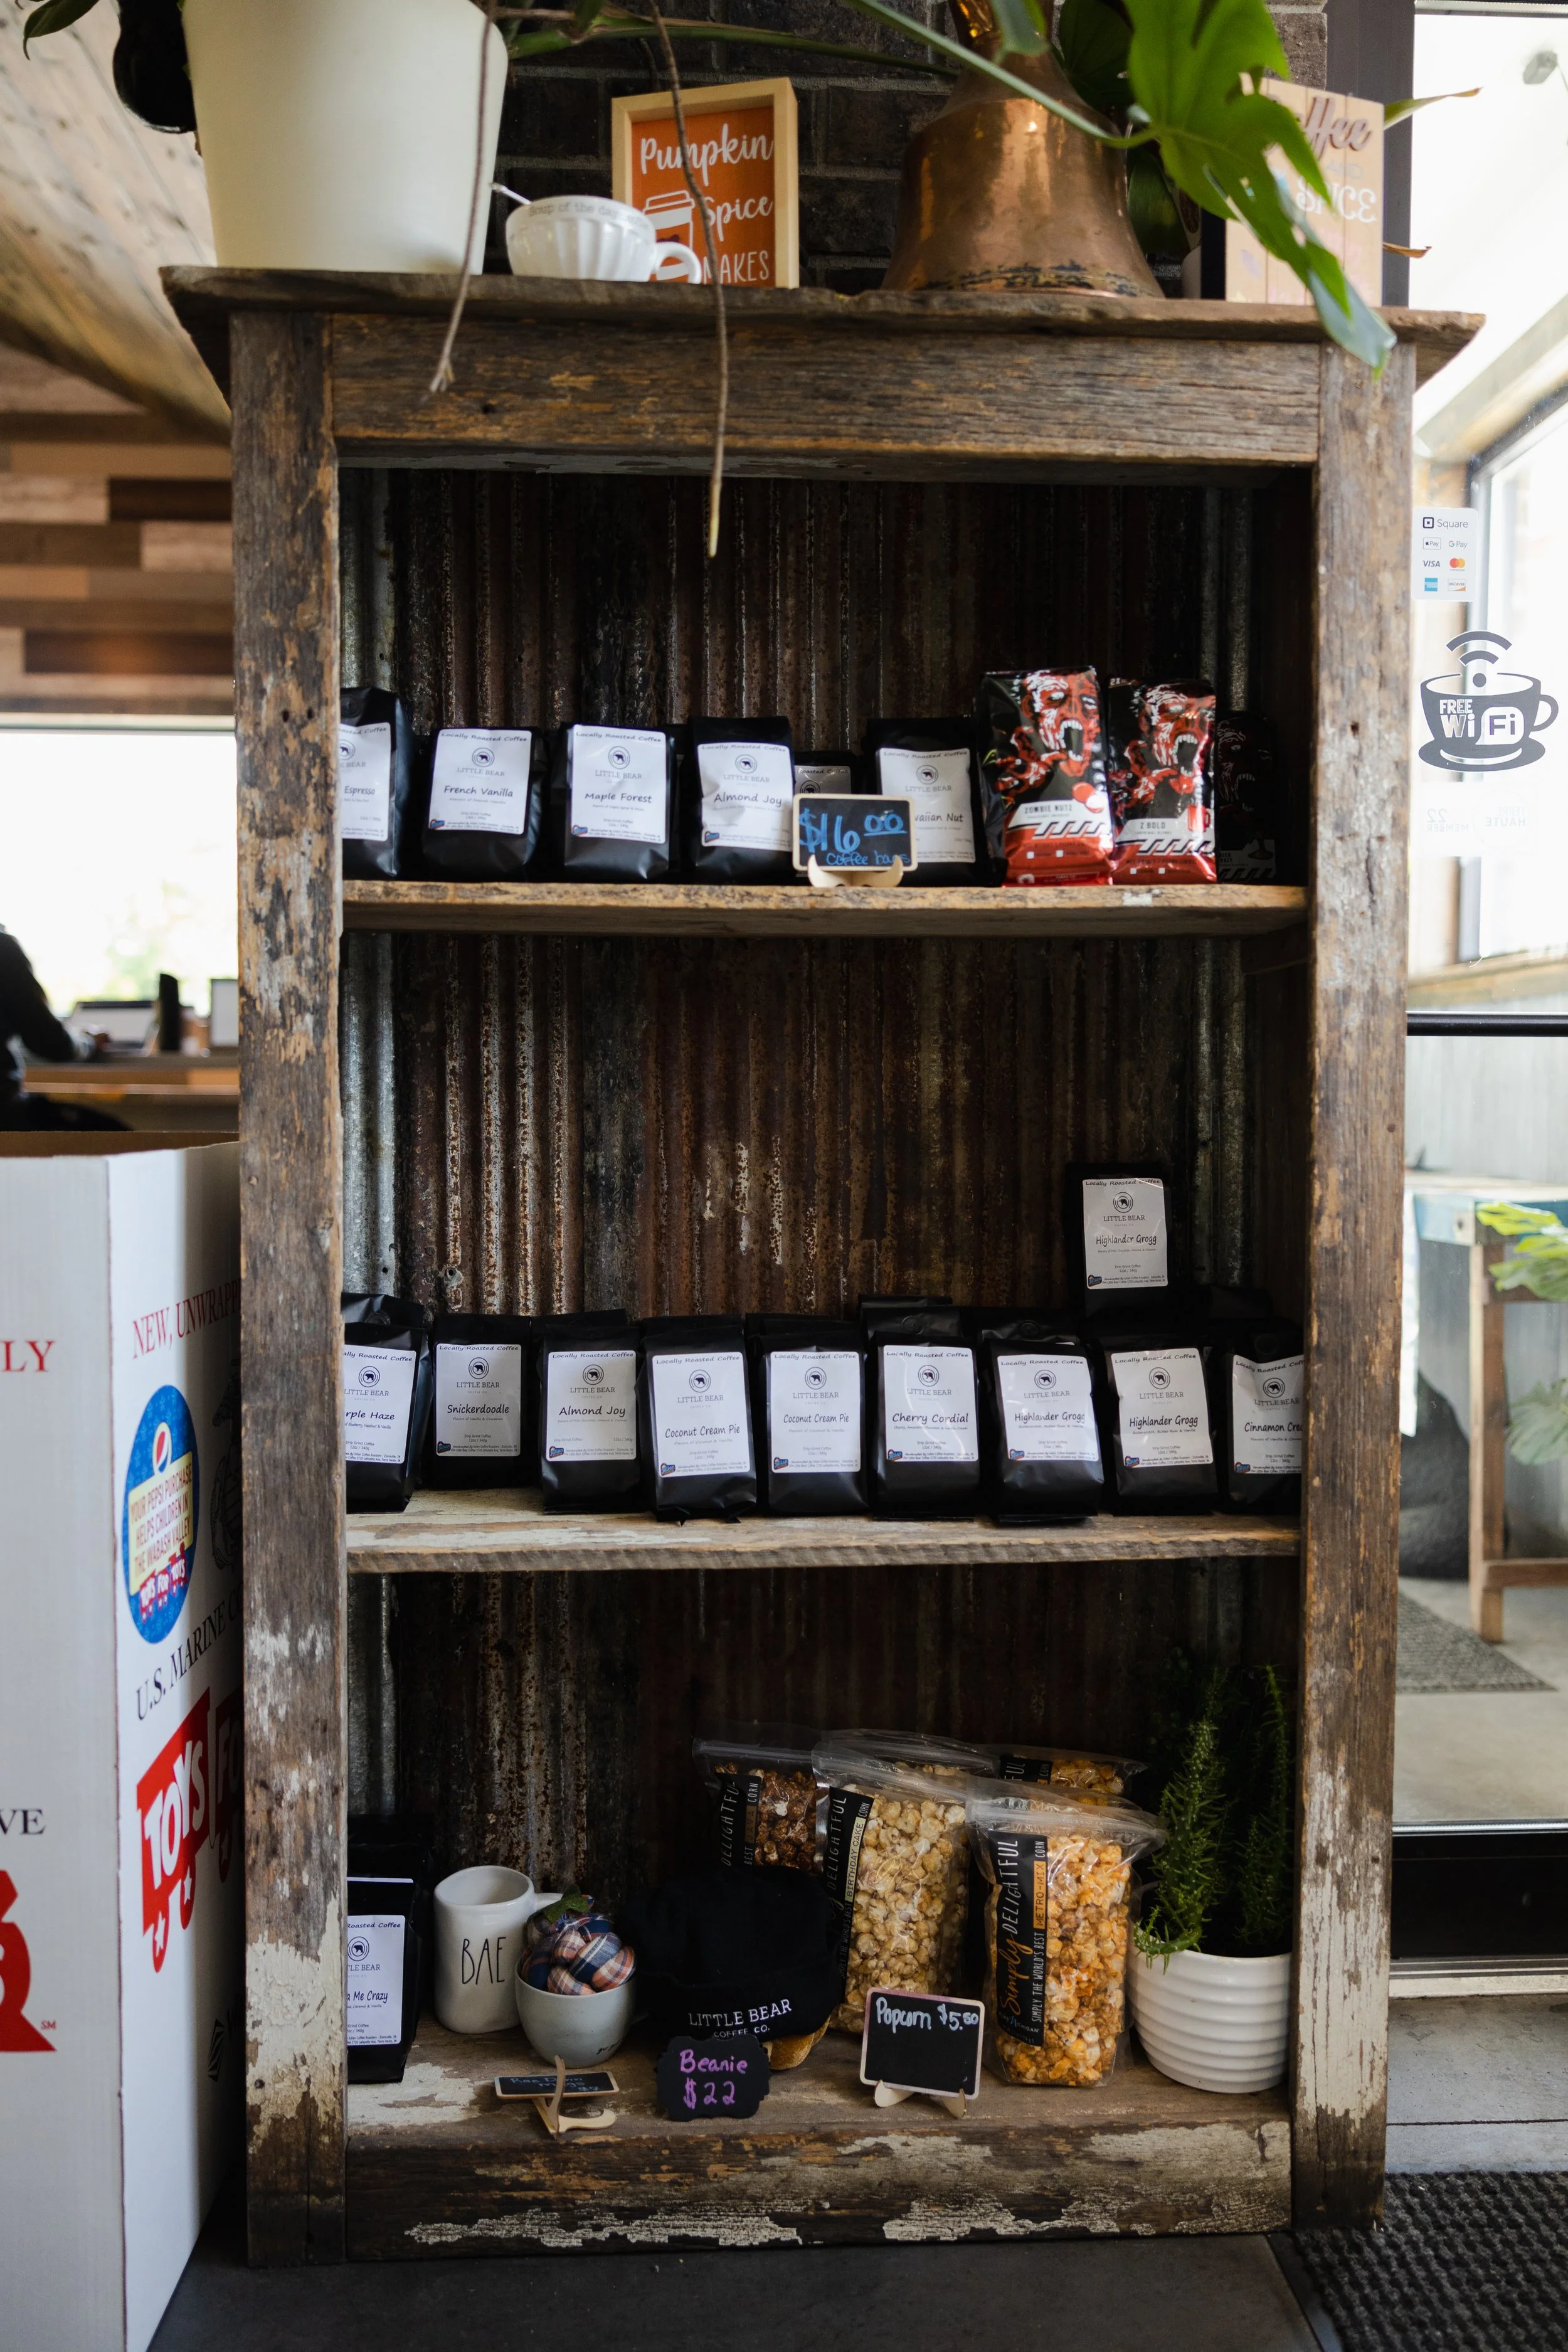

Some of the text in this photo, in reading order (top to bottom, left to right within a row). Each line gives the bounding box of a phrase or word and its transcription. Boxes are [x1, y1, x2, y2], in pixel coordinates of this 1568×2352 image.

[641, 123, 775, 186] Pumpkin
[702, 196, 773, 241] Spice
[1437, 519, 1468, 529] Square
[1456, 541, 1468, 549] Pay
[1439, 699, 1473, 714] FREE
[595, 770, 621, 779] LITTLE
[344, 785, 376, 797] Espresso
[444, 785, 514, 798] French Vanilla
[585, 792, 652, 803] Maple Forest
[714, 792, 783, 808] Almond Joy
[946, 812, 964, 822] Nut
[1024, 806, 1051, 814] ZOMBIE
[826, 850, 911, 866] coffee bas
[1096, 1234, 1157, 1247] Highlander Grogg
[133, 1307, 172, 1359] NEW,
[1236, 1360, 1286, 1373] Locally Roasted
[346, 1410, 395, 1420] rple Haze
[447, 1404, 509, 1414] Snickerdoodle
[559, 1406, 625, 1417] Almond Joy
[783, 1413, 849, 1424] Coconut Cream Pie
[892, 1412, 968, 1424] Cherry Cordial
[1015, 1411, 1085, 1424] Highlander Grogg
[1130, 1415, 1198, 1429] Highlander Grogg
[665, 1423, 741, 1438] Coconut Cream Pie
[1244, 1422, 1285, 1432] Cinnamon
[130, 1464, 192, 1525] YOUR PEPSI PURCHASE
[135, 1517, 154, 1547] HELPS
[156, 1500, 181, 1535] CHILDREN
[134, 1513, 191, 1577] THE WABASH VALLEY
[157, 1573, 169, 1595] FOR
[137, 1601, 226, 1720] U.S. MARINE
[748, 1783, 758, 1803] CORN
[144, 1740, 204, 1891] TOYS
[858, 1801, 871, 1818] CORN
[721, 1780, 741, 1867] DELIGHTFUL
[826, 1796, 847, 1890] DELIGHTFUL
[852, 1821, 865, 1852] CAKE
[847, 1855, 858, 1898] BIRTHDAY
[997, 1840, 1034, 2016] Simply DELIGHTFUL
[1032, 1841, 1046, 2023] SIMPLY THE WORLD'S BEST METRO-MIX CORN
[462, 1936, 507, 1985] BAE
[353, 1990, 388, 2003] Me Crazy
[688, 1999, 792, 2026] LITTLE BEAR
[876, 1996, 932, 2033] Popcorn
[41, 2020, 56, 2030] SM
[754, 2024, 770, 2033] CO.
[679, 2048, 748, 2074] Beanie
